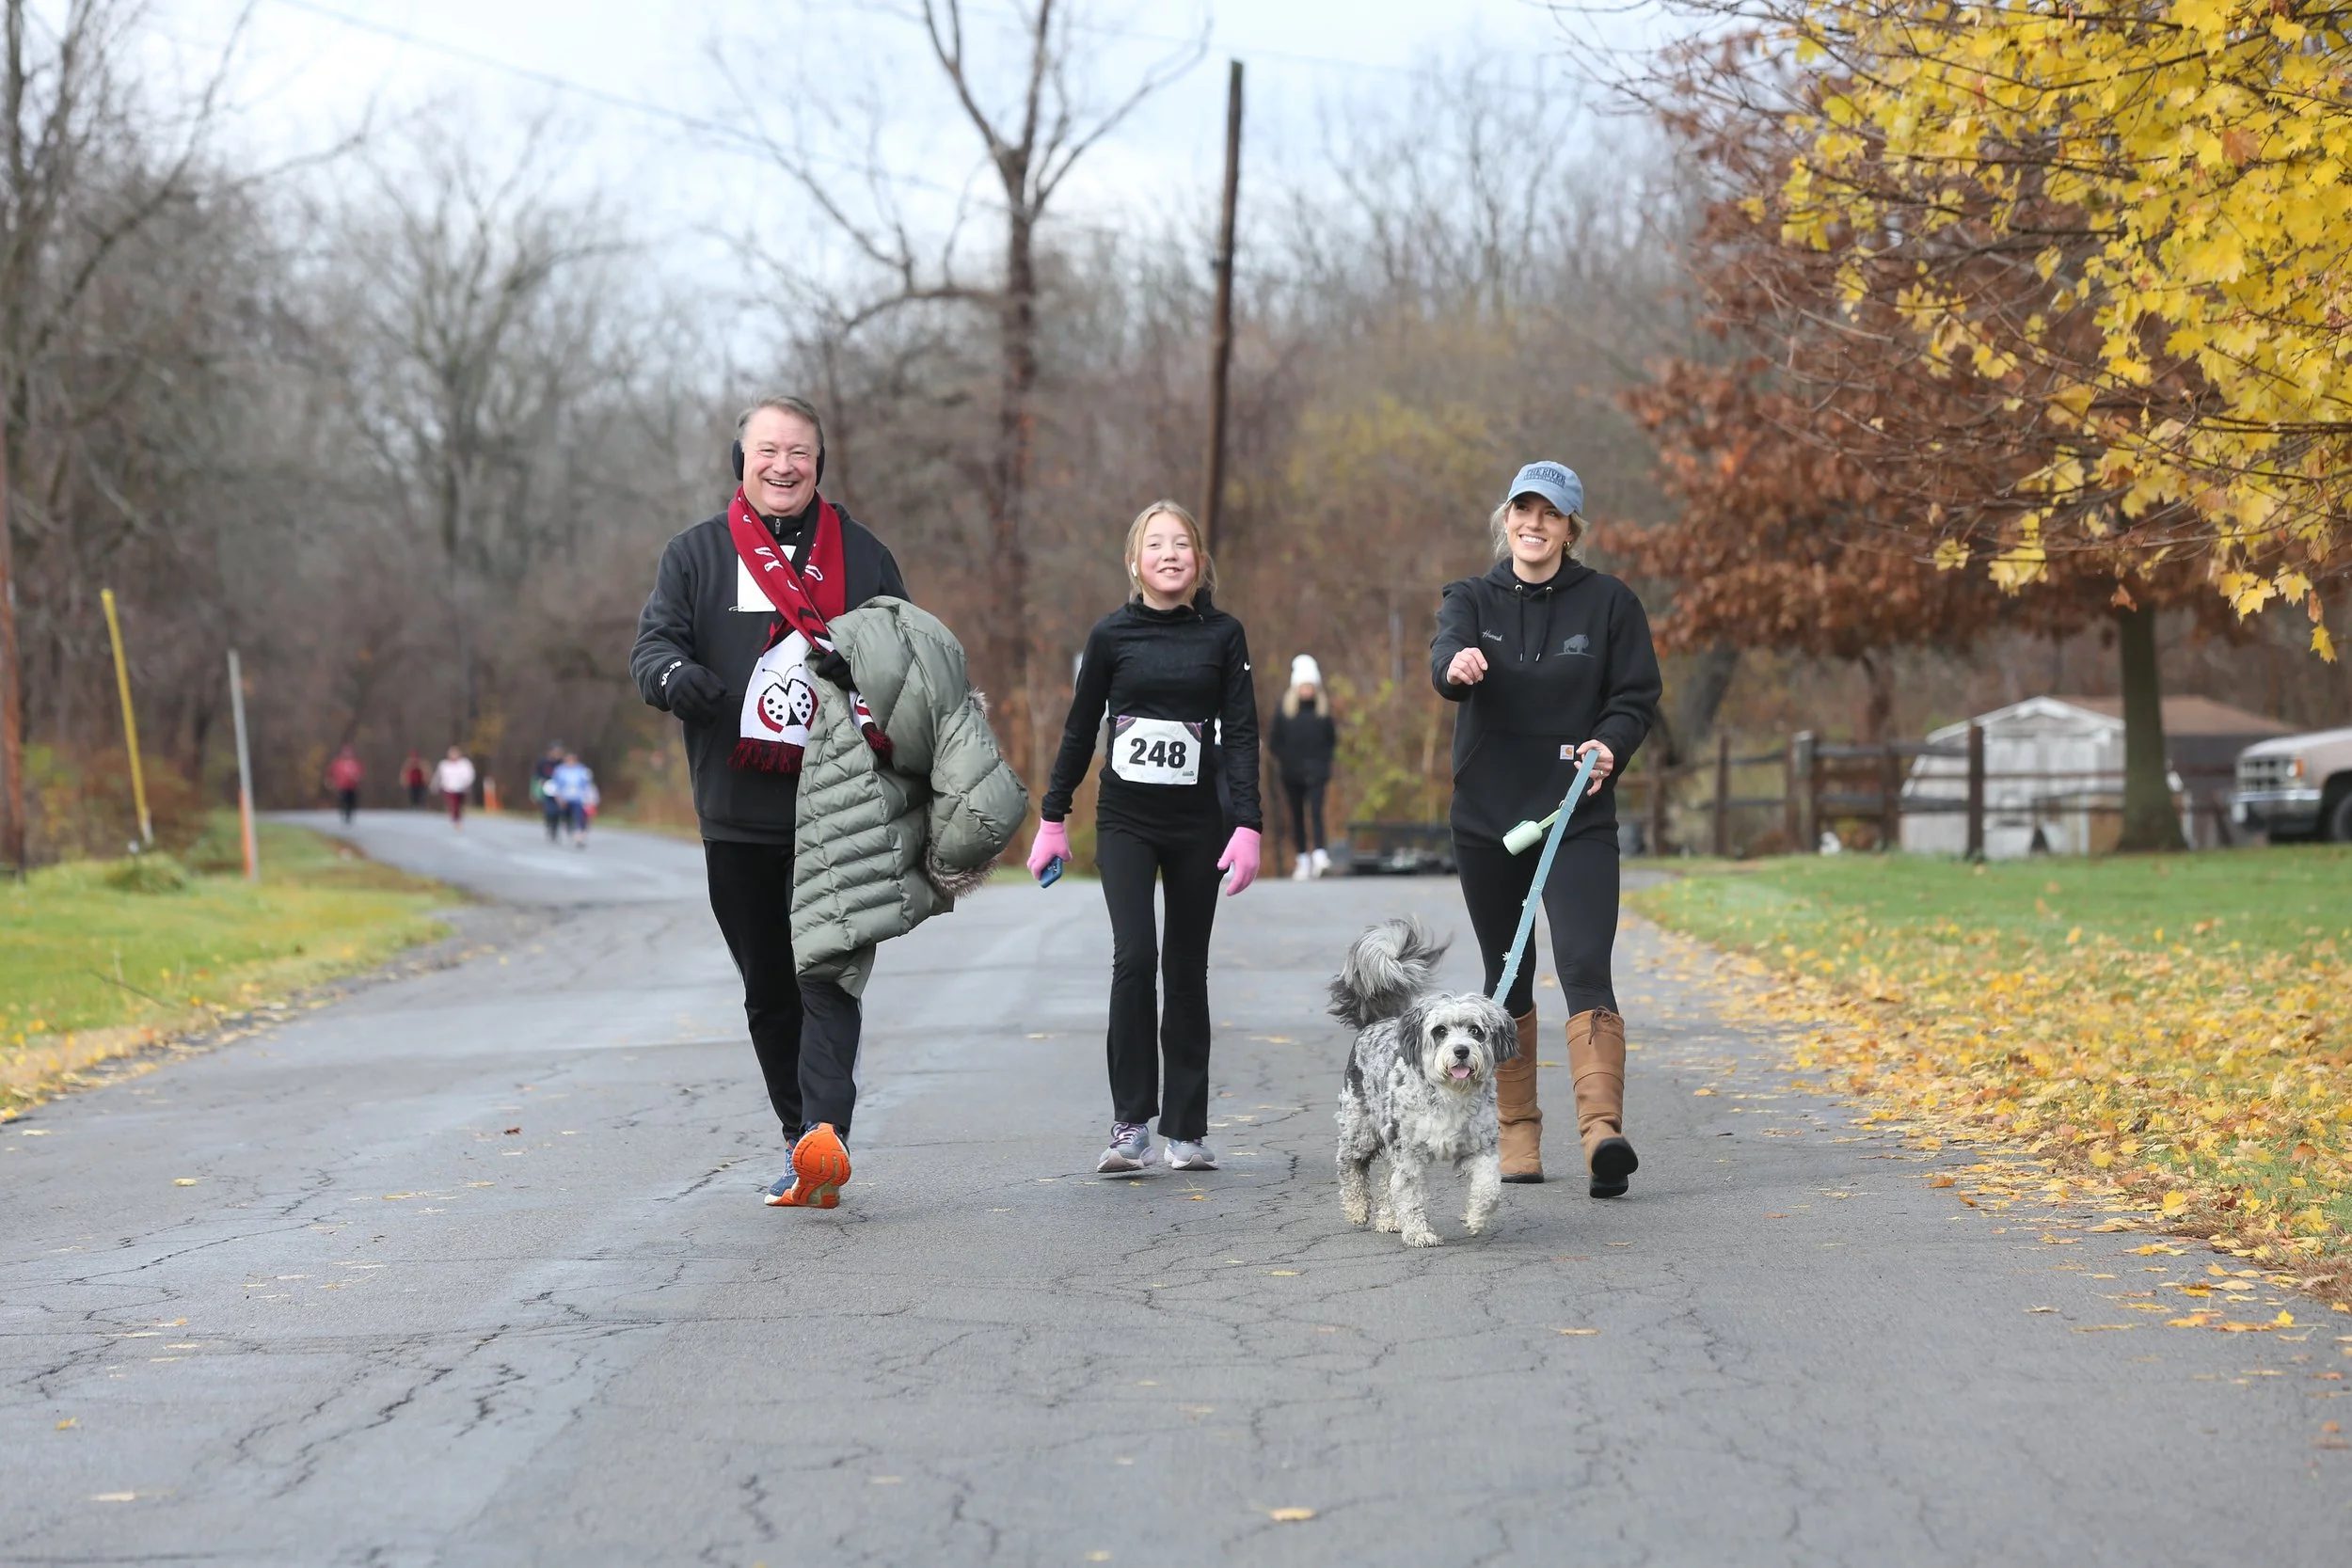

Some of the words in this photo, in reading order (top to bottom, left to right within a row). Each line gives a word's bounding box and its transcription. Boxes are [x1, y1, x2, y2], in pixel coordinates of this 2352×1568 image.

[1527, 467, 1542, 476] THE
[1543, 467, 1566, 483] RIVER
[1129, 737, 1186, 769] 248
